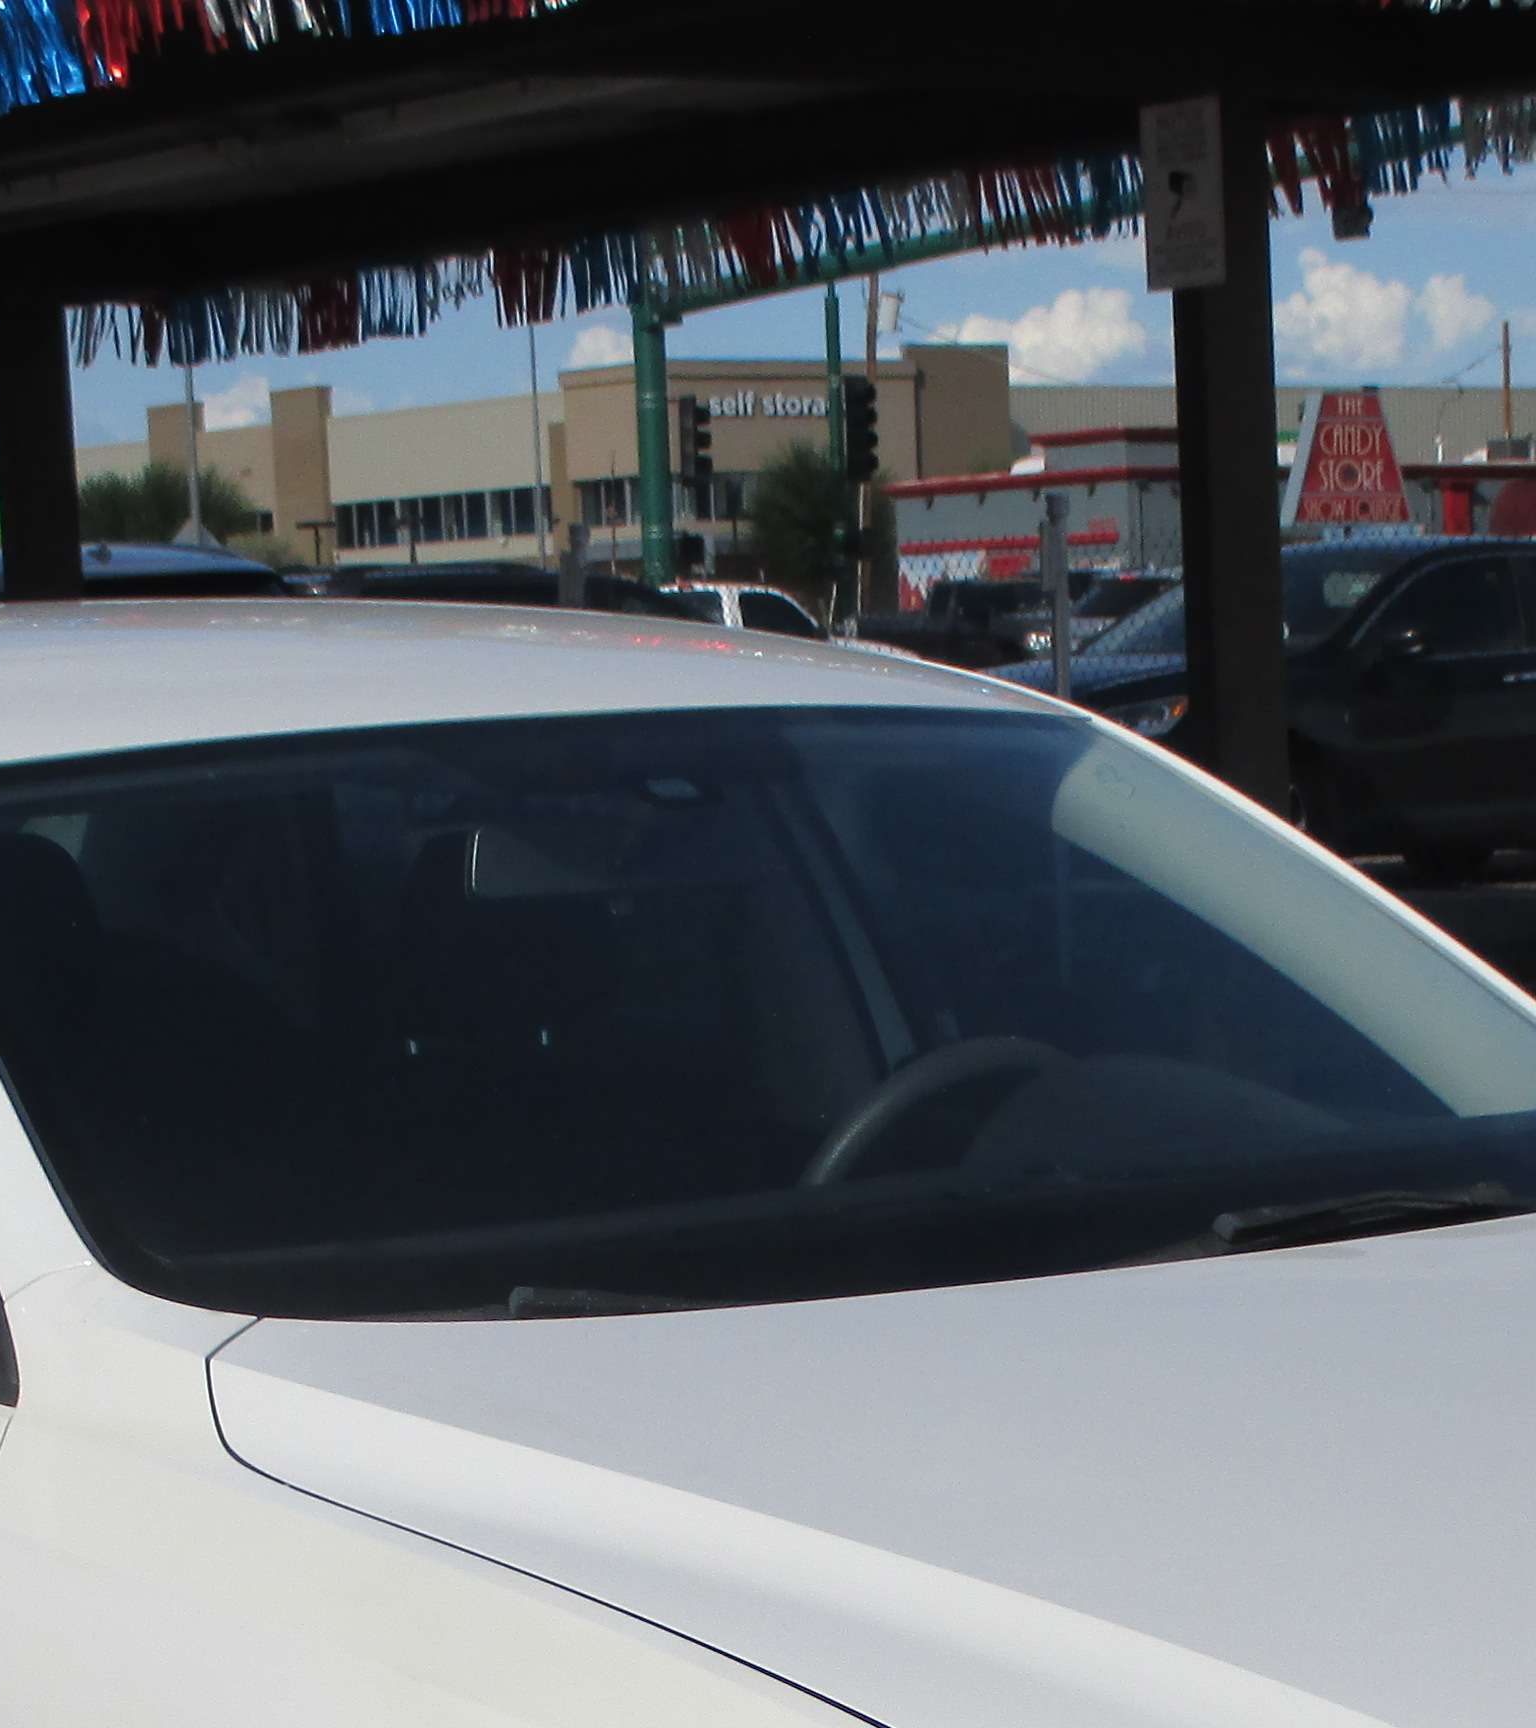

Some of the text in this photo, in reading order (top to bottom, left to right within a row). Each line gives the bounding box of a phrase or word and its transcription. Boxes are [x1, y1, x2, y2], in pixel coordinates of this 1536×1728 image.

[709, 389, 829, 416] self stora
[1338, 396, 1363, 416] THE
[1320, 424, 1383, 455] CANDY
[1318, 459, 1385, 492] STORE
